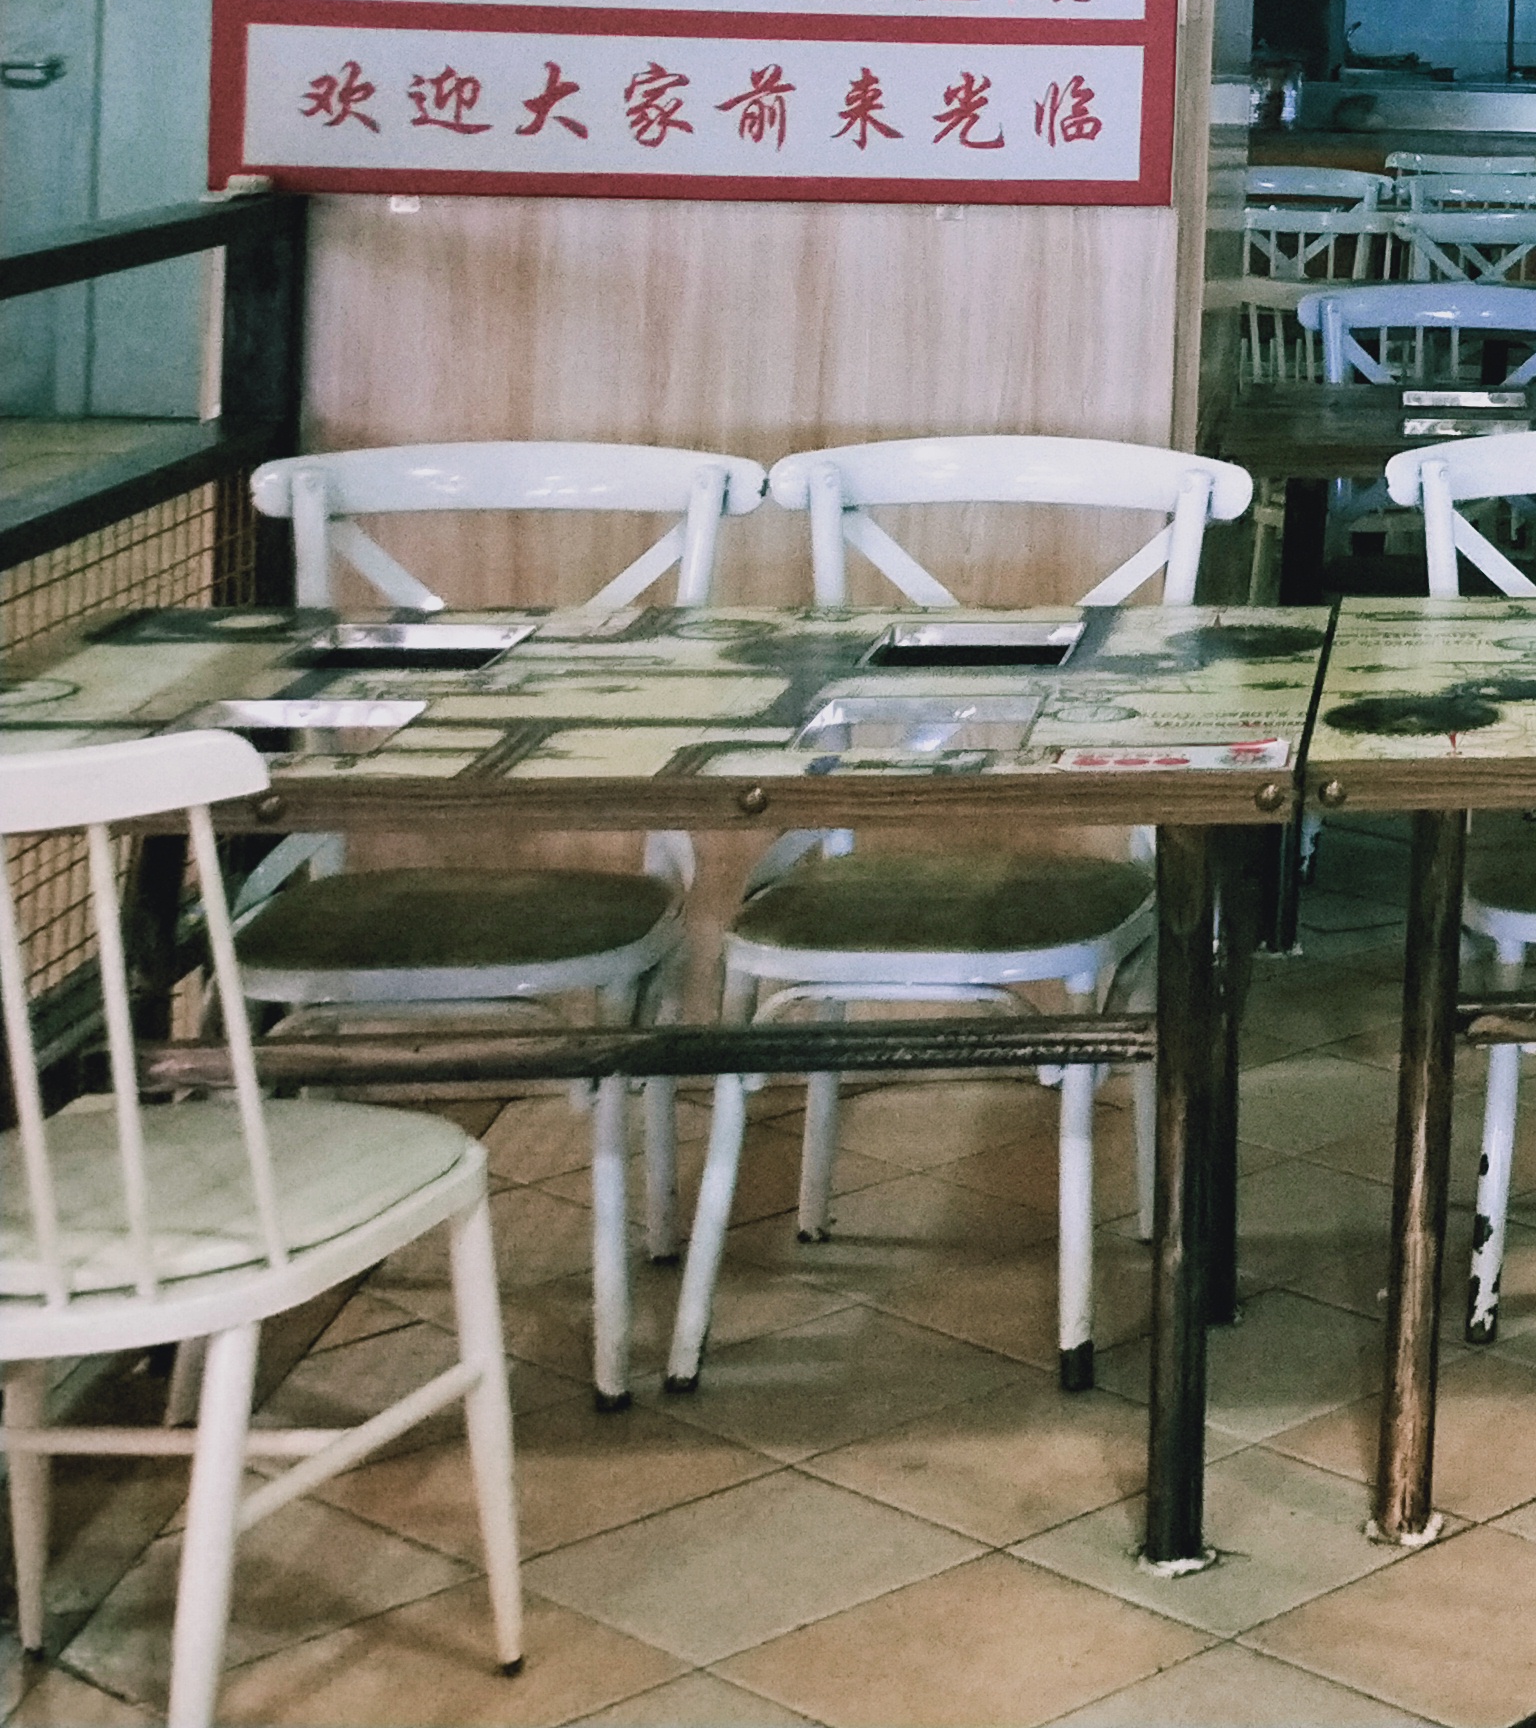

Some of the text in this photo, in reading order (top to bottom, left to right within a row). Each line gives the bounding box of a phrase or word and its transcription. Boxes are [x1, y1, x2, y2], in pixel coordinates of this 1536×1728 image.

[299, 60, 1104, 152] 欢迎大家前来光临
